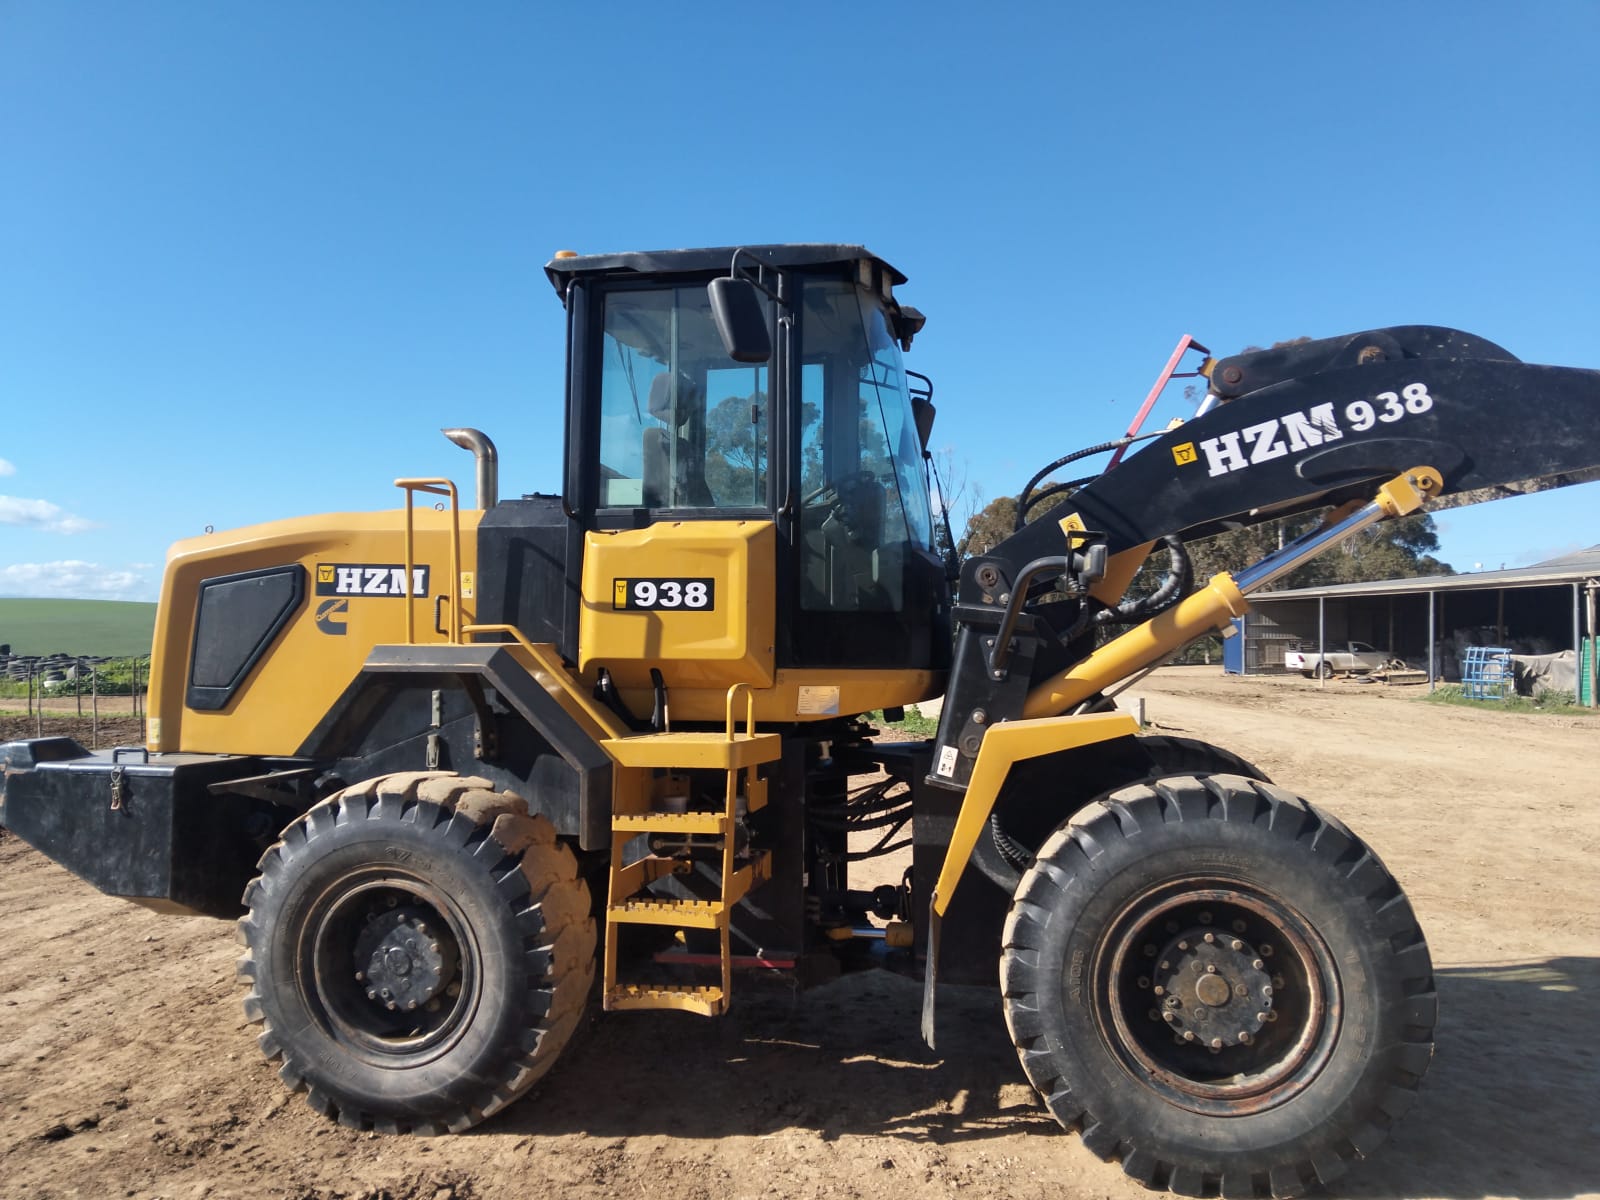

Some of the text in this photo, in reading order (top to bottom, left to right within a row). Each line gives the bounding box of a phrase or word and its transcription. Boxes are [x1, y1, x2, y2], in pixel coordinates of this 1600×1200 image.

[1199, 382, 1434, 478] HZM 938
[335, 567, 426, 595] HZM
[634, 581, 708, 608] 938
